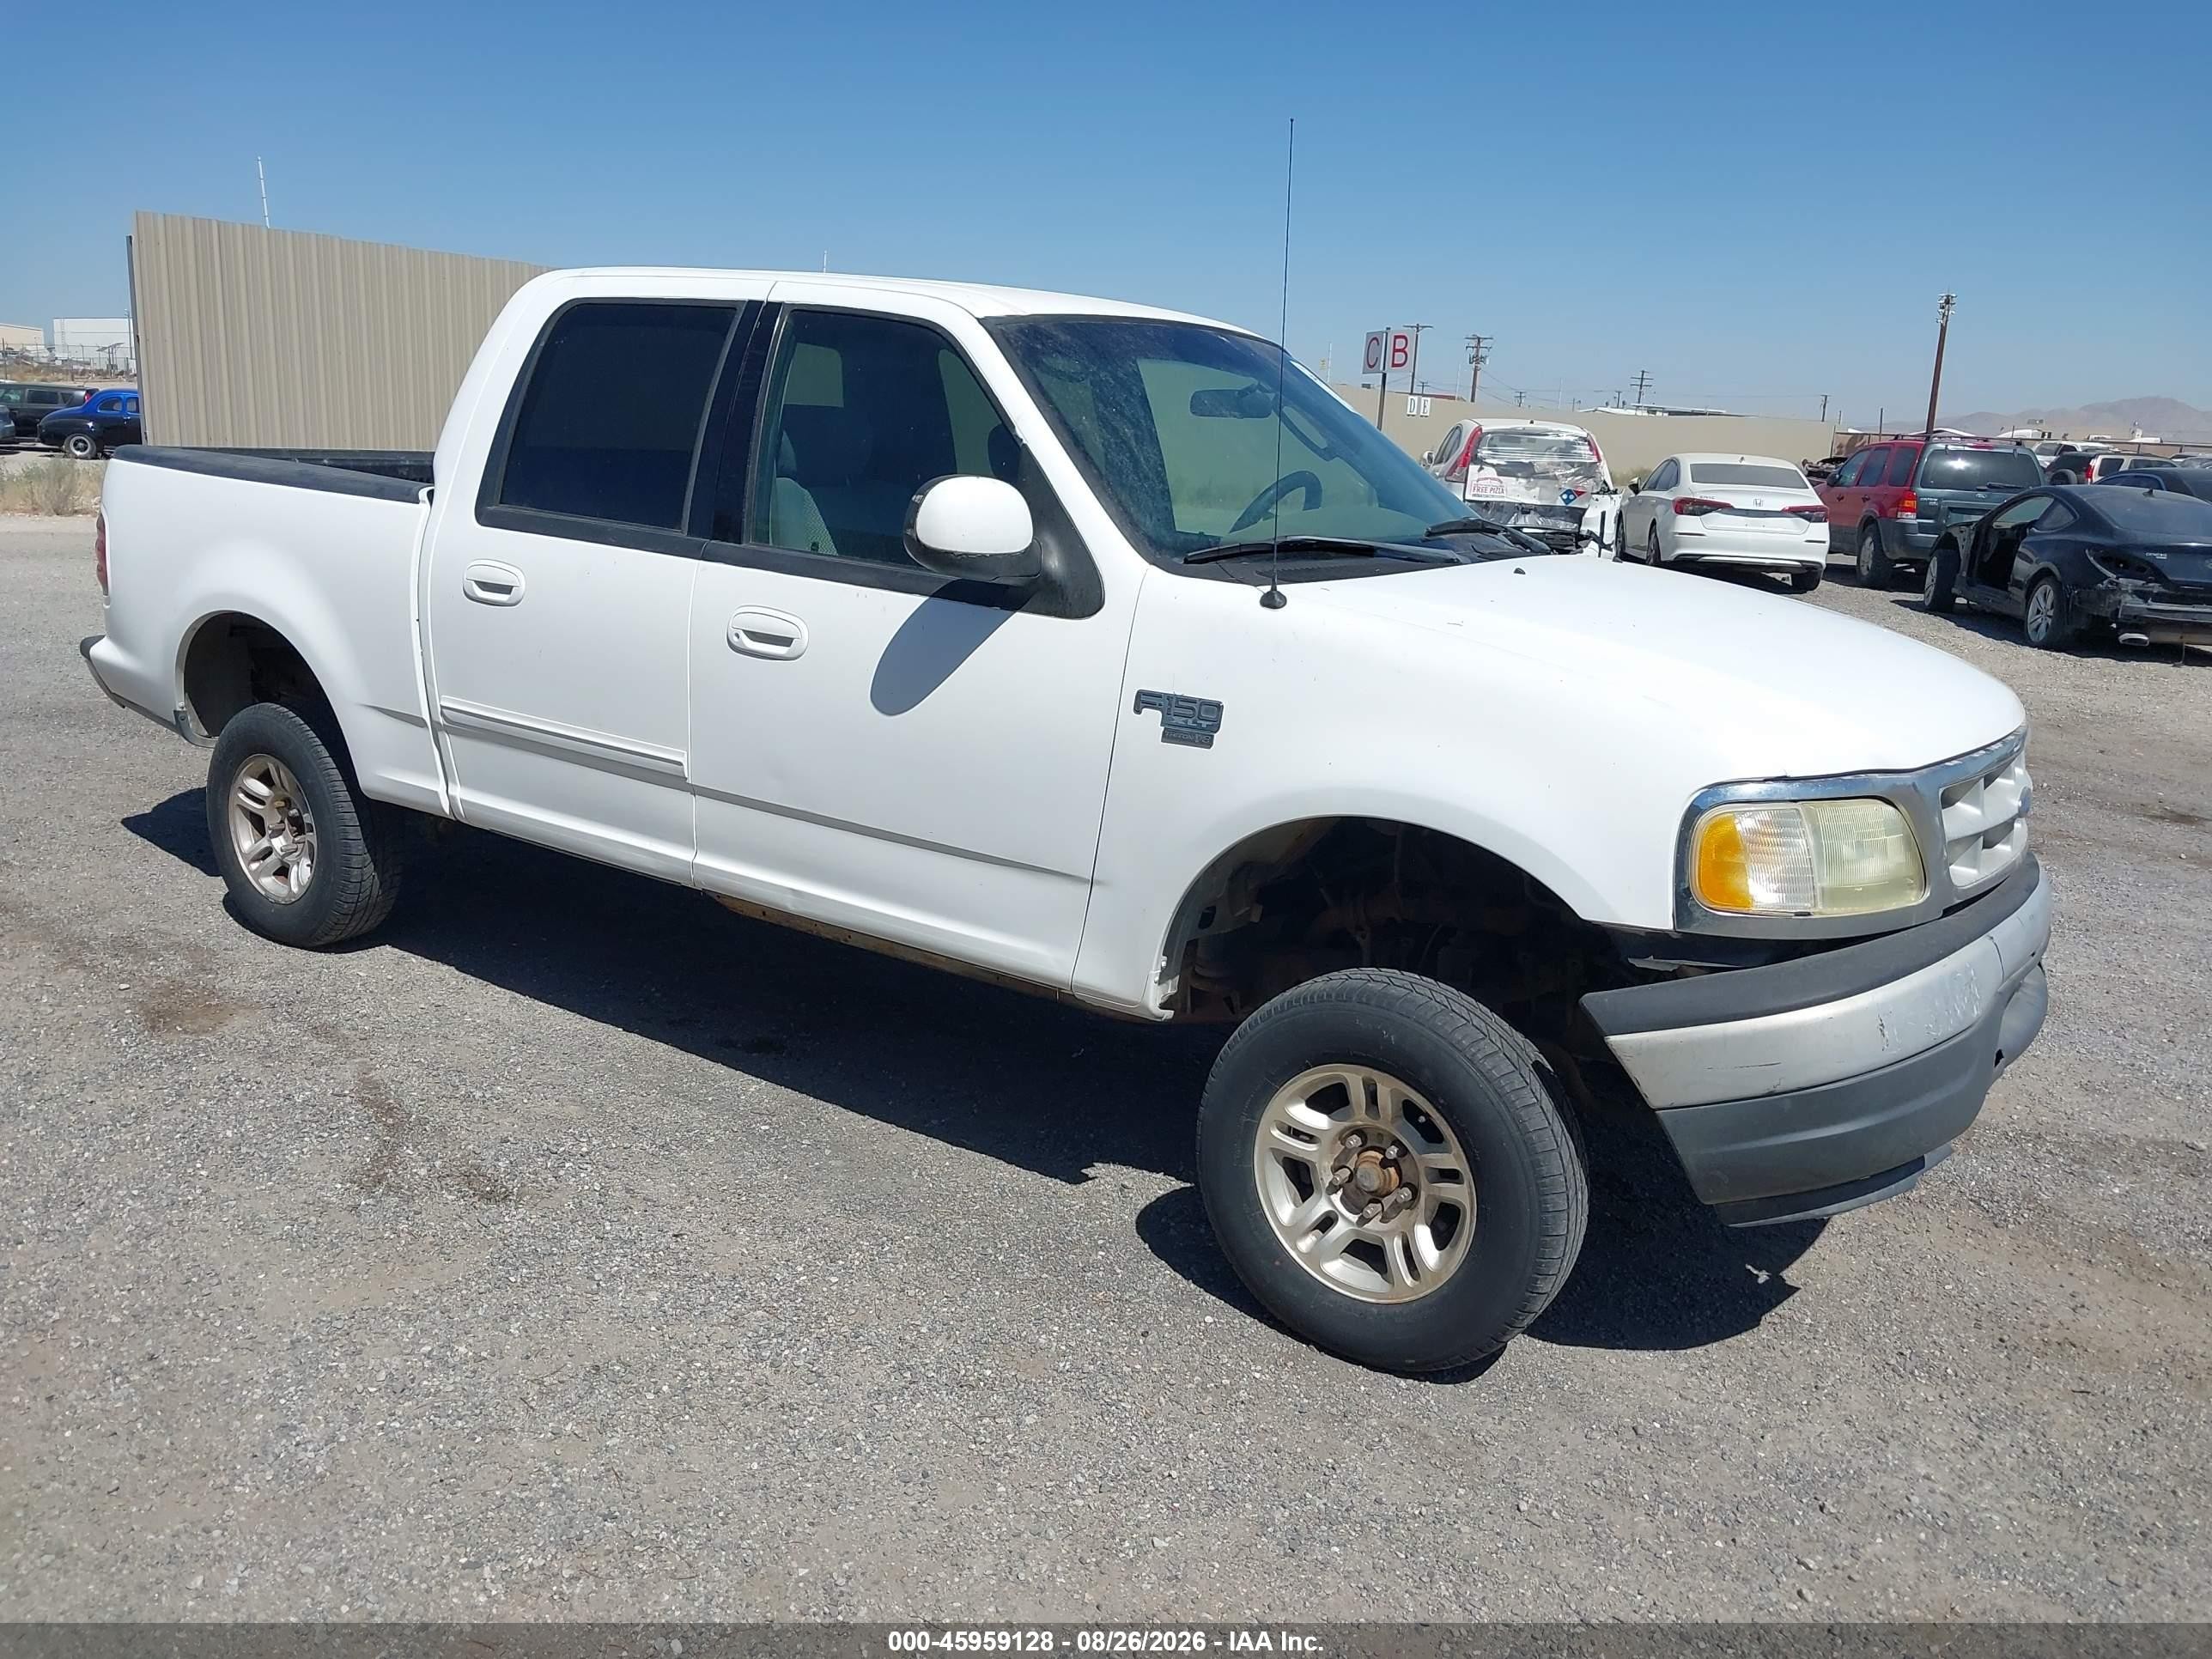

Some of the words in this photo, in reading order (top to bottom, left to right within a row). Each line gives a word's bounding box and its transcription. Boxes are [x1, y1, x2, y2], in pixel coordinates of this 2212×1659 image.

[1366, 336, 1380, 369] C
[1391, 334, 1408, 368] B
[1409, 398, 1416, 413] D
[1422, 398, 1429, 414] E
[1167, 715, 1212, 728] XLT
[1194, 733, 1211, 744] V8
